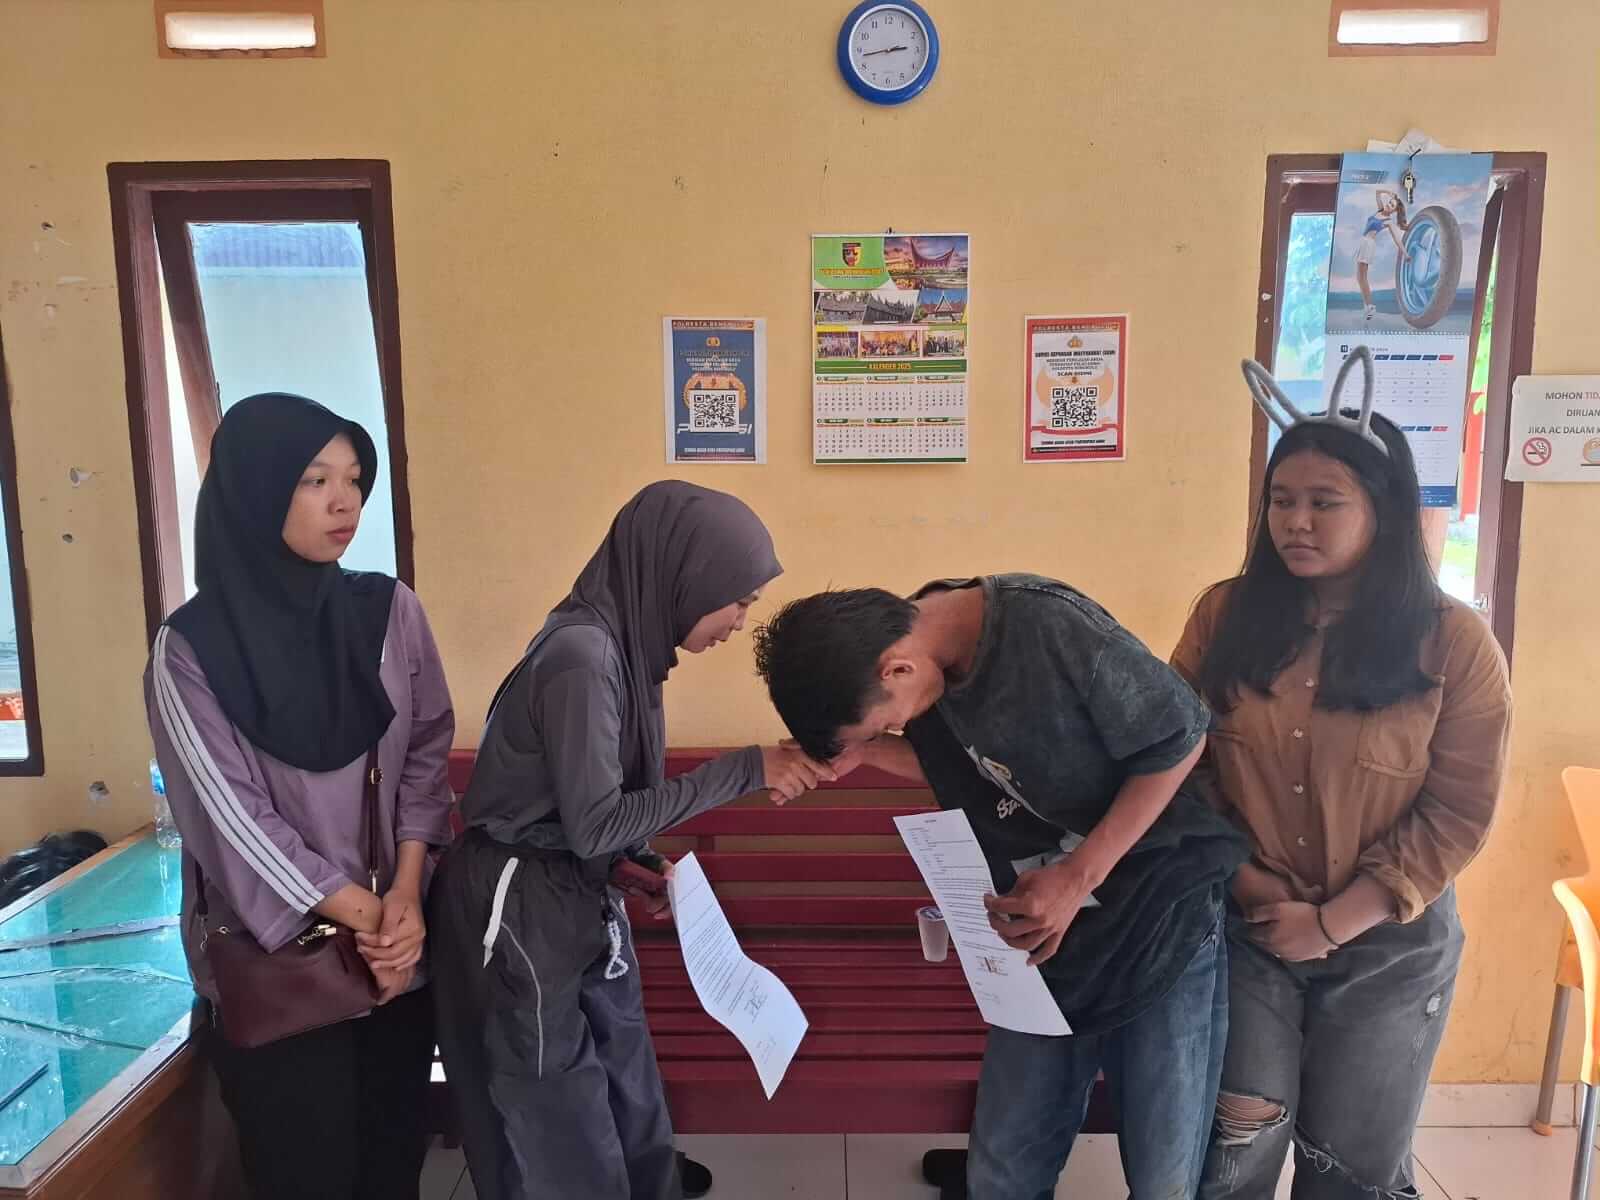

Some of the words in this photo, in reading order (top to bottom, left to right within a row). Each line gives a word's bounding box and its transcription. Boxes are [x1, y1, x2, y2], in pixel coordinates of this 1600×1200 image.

[1545, 391, 1583, 400] MOHON
[1585, 391, 1600, 400] TID
[1528, 426, 1547, 434] JIKA
[1548, 426, 1561, 434] AC
[1563, 426, 1595, 434] DALAM
